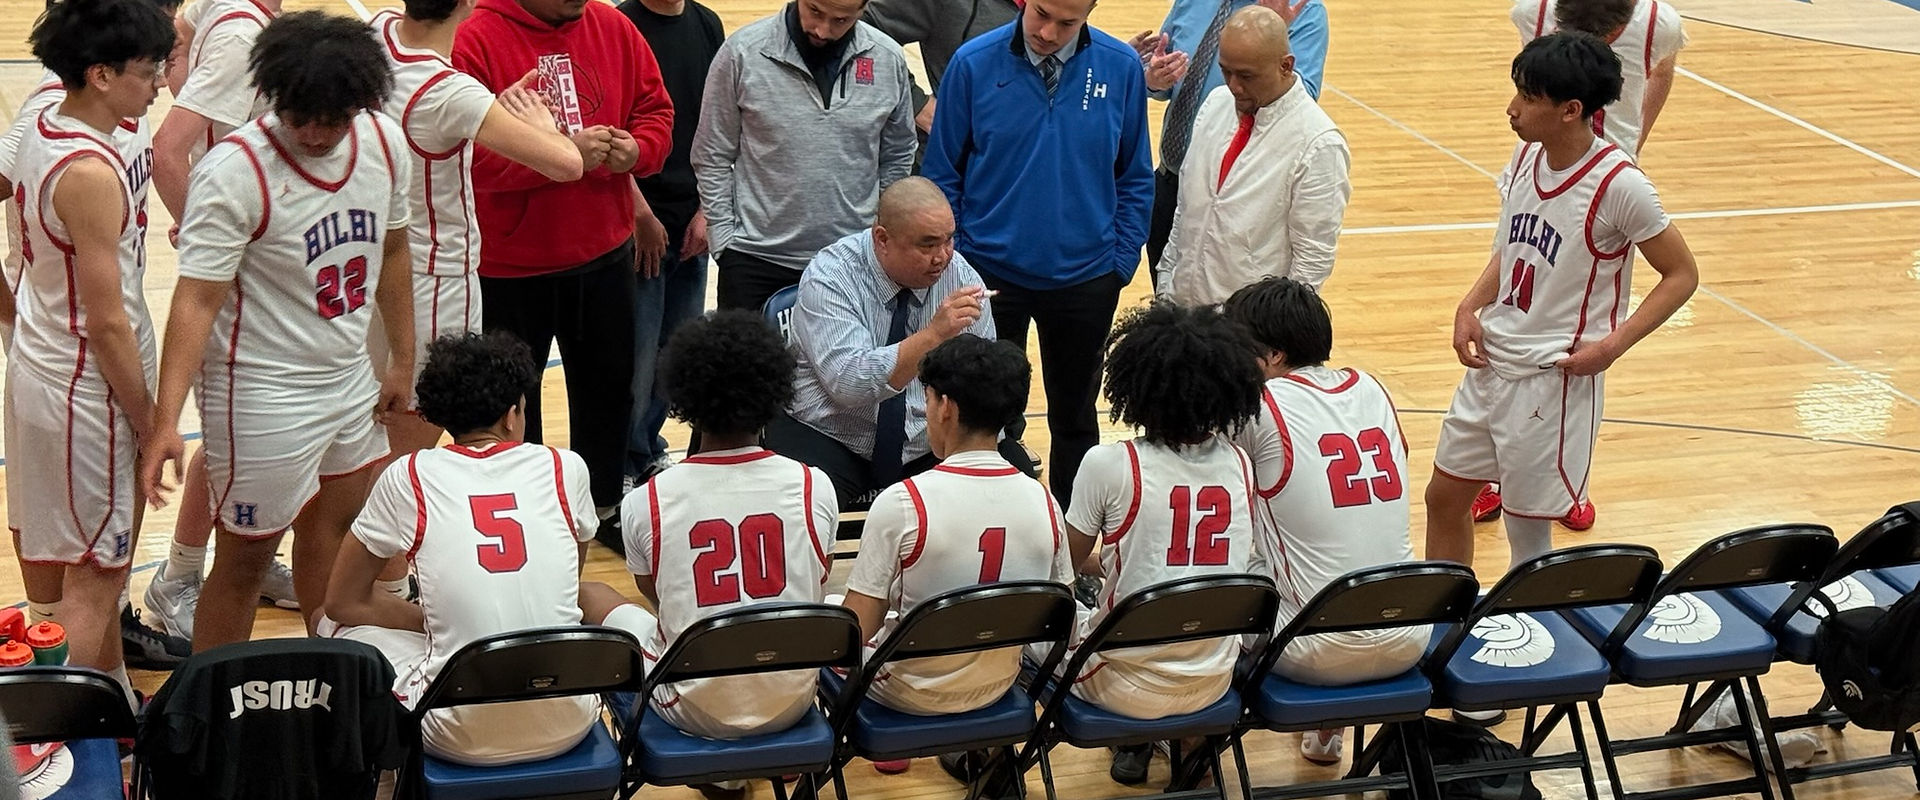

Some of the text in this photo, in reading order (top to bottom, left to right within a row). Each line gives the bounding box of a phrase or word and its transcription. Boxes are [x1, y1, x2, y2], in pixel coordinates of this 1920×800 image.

[856, 57, 874, 80] H
[1083, 67, 1093, 110] SPARTANS
[1093, 83, 1107, 98] H
[556, 60, 581, 135] HILH
[303, 209, 377, 267] HILHI
[1508, 213, 1562, 268] HILHI
[316, 254, 368, 320] 22
[1318, 426, 1403, 508] 23
[233, 501, 257, 527] H
[468, 492, 528, 574] 5
[1165, 485, 1232, 566] 12
[114, 529, 131, 559] H
[688, 512, 786, 607] 20
[978, 527, 1006, 582] 1
